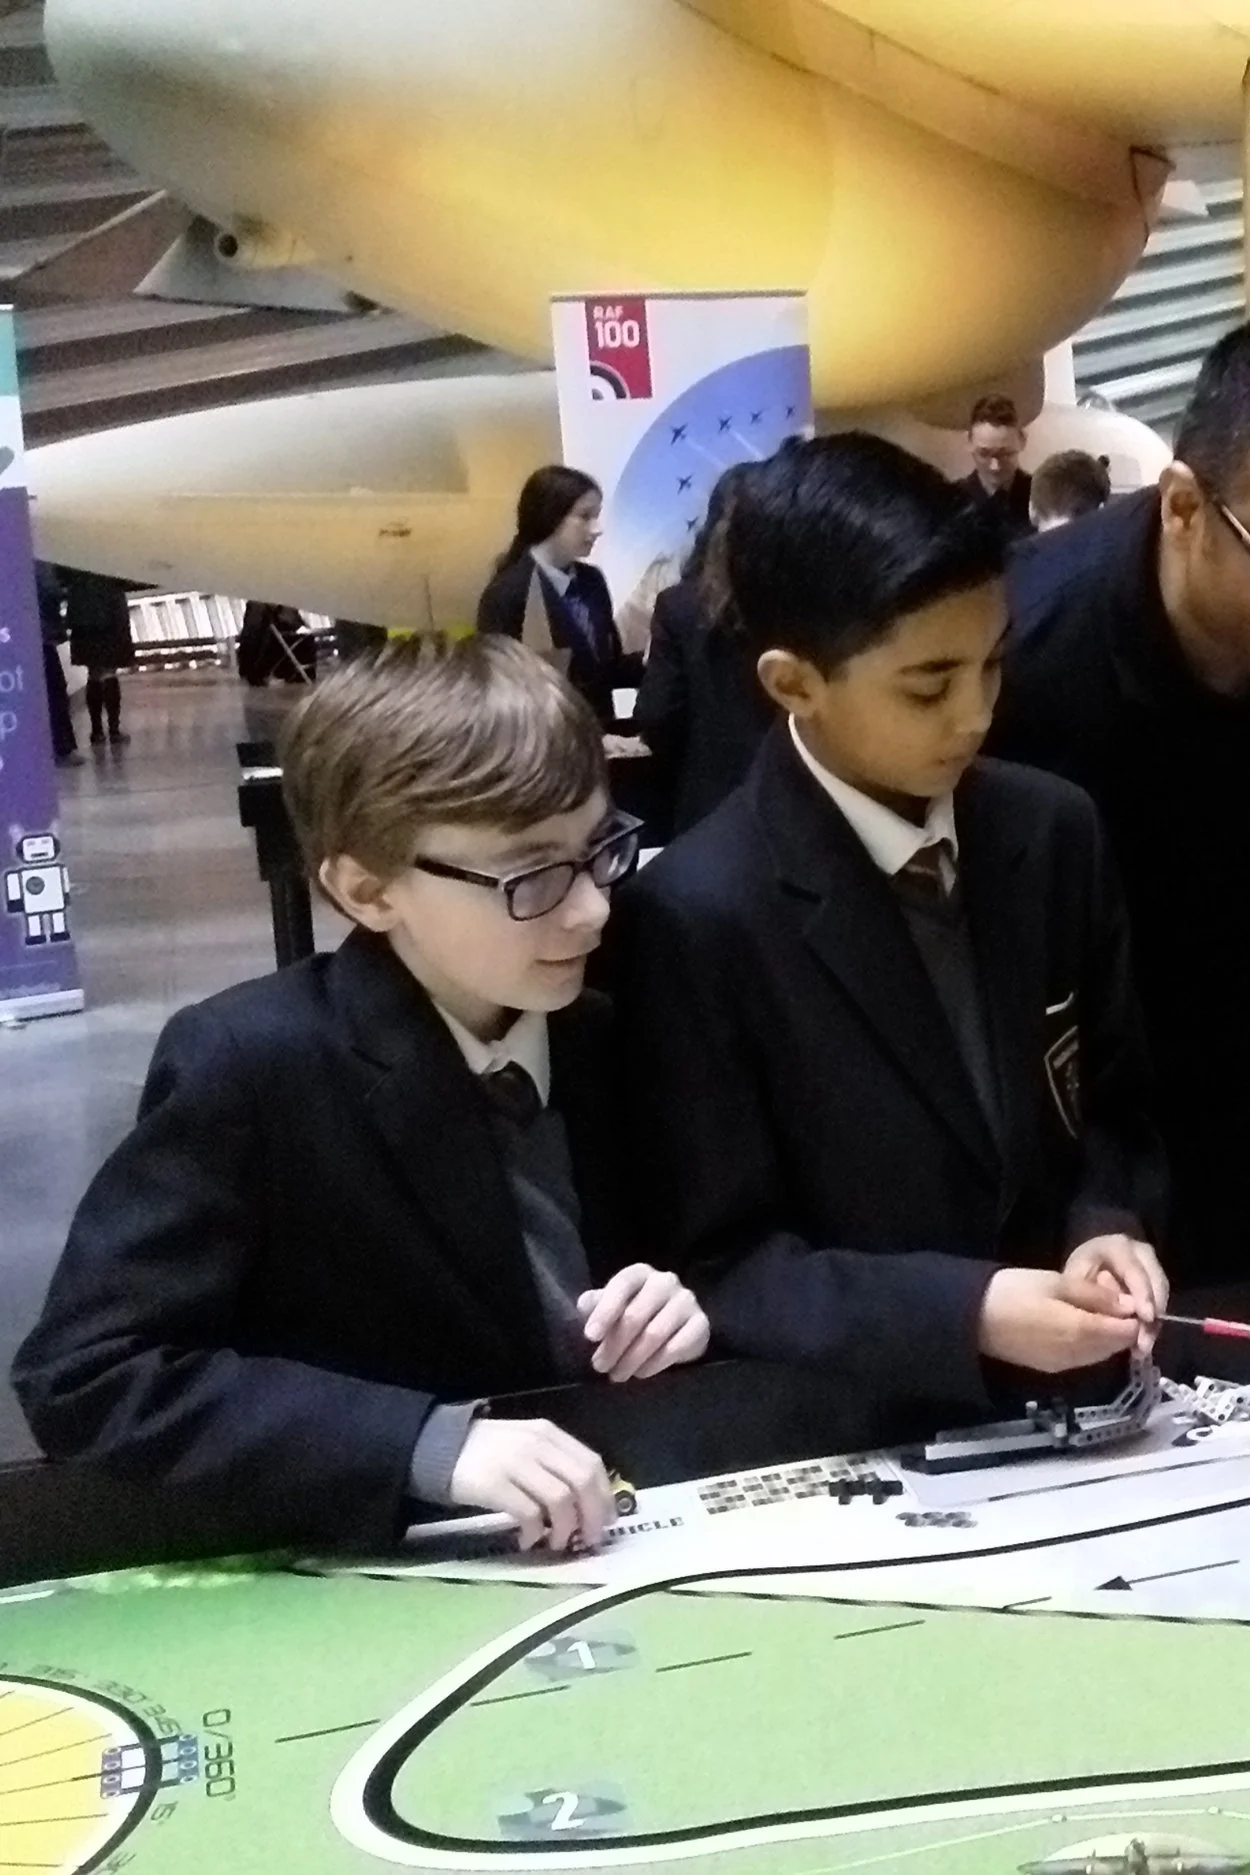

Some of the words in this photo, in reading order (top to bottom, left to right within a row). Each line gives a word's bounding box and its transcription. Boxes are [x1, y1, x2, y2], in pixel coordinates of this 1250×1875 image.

[593, 305, 623, 320] RAF
[595, 320, 640, 350] 100
[567, 1640, 596, 1670] 1
[542, 1791, 586, 1831] 2
